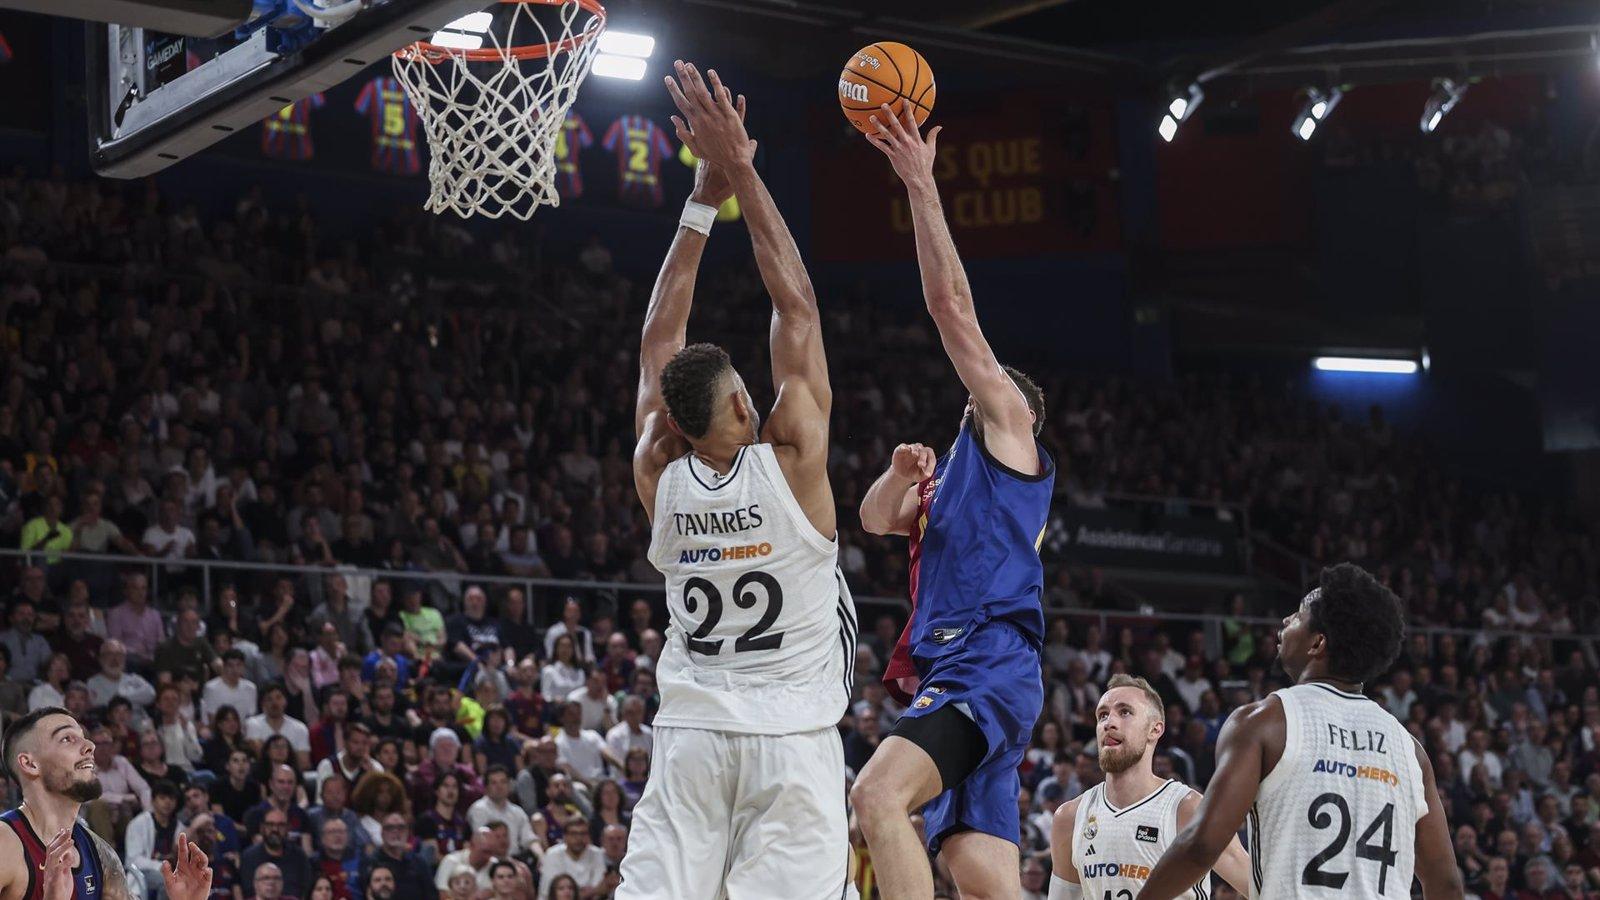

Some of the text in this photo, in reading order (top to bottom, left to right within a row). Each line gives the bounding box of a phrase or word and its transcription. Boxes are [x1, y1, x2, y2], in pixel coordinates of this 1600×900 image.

[147, 37, 184, 70] GAMEDAY
[384, 103, 405, 136] 5
[628, 140, 649, 171] 2
[968, 139, 1042, 186] QUE
[954, 187, 1043, 227] CLUB
[673, 504, 763, 536] TAVARES
[679, 542, 773, 564] AUTOHERO
[683, 571, 786, 656] 22
[1328, 723, 1387, 755] FELIZ
[1312, 759, 1399, 788] AUTOHERO
[1302, 792, 1399, 897] 24
[1083, 863, 1151, 880] AUTOHER
